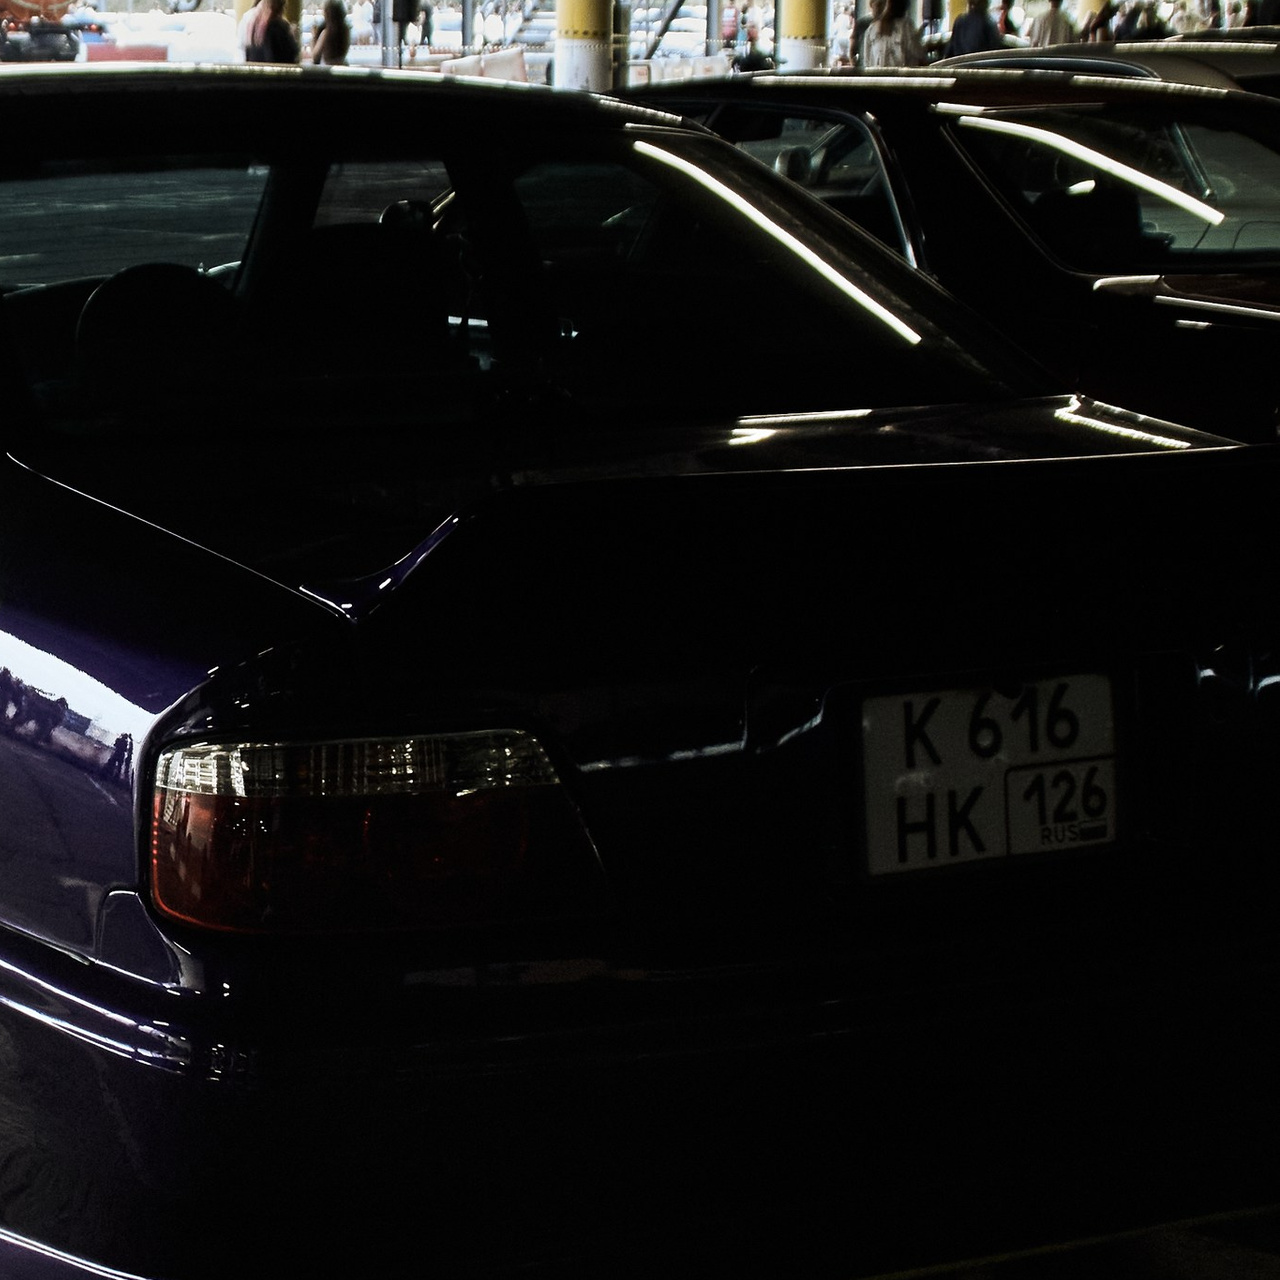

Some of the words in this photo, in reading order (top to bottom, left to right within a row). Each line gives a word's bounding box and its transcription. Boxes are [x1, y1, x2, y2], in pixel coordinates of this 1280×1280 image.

[970, 683, 1079, 758] 616
[1023, 766, 1107, 825] 126
[1041, 825, 1079, 845] RUS
